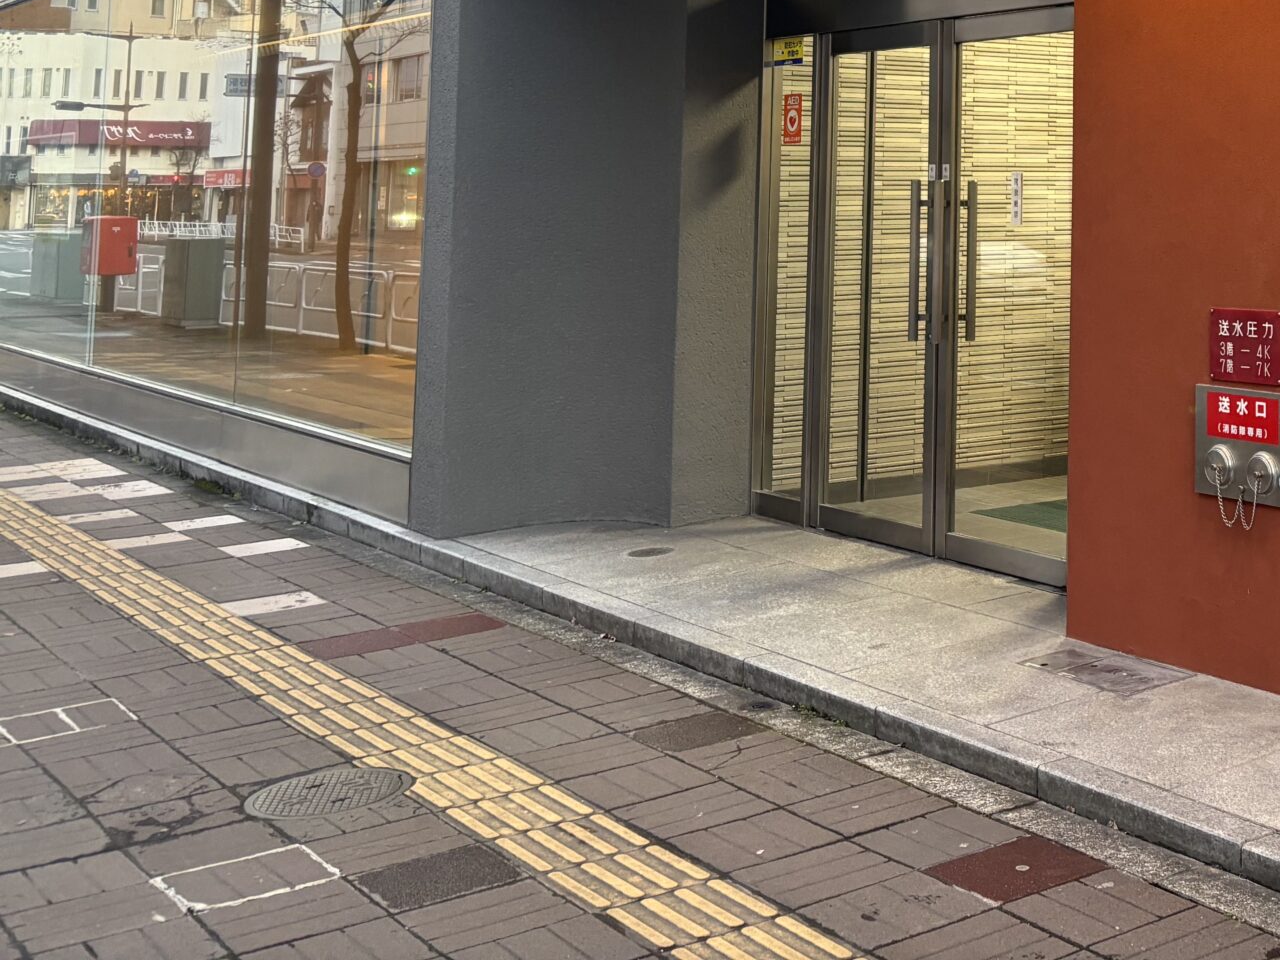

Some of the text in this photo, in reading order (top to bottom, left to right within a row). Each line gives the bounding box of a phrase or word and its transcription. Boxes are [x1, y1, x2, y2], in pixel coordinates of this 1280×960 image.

[787, 96, 800, 105] AED
[1218, 319, 1274, 339] 送水圧力
[1256, 344, 1271, 360] 4K
[1256, 361, 1271, 378] 7K
[1218, 395, 1267, 418] 送水口
